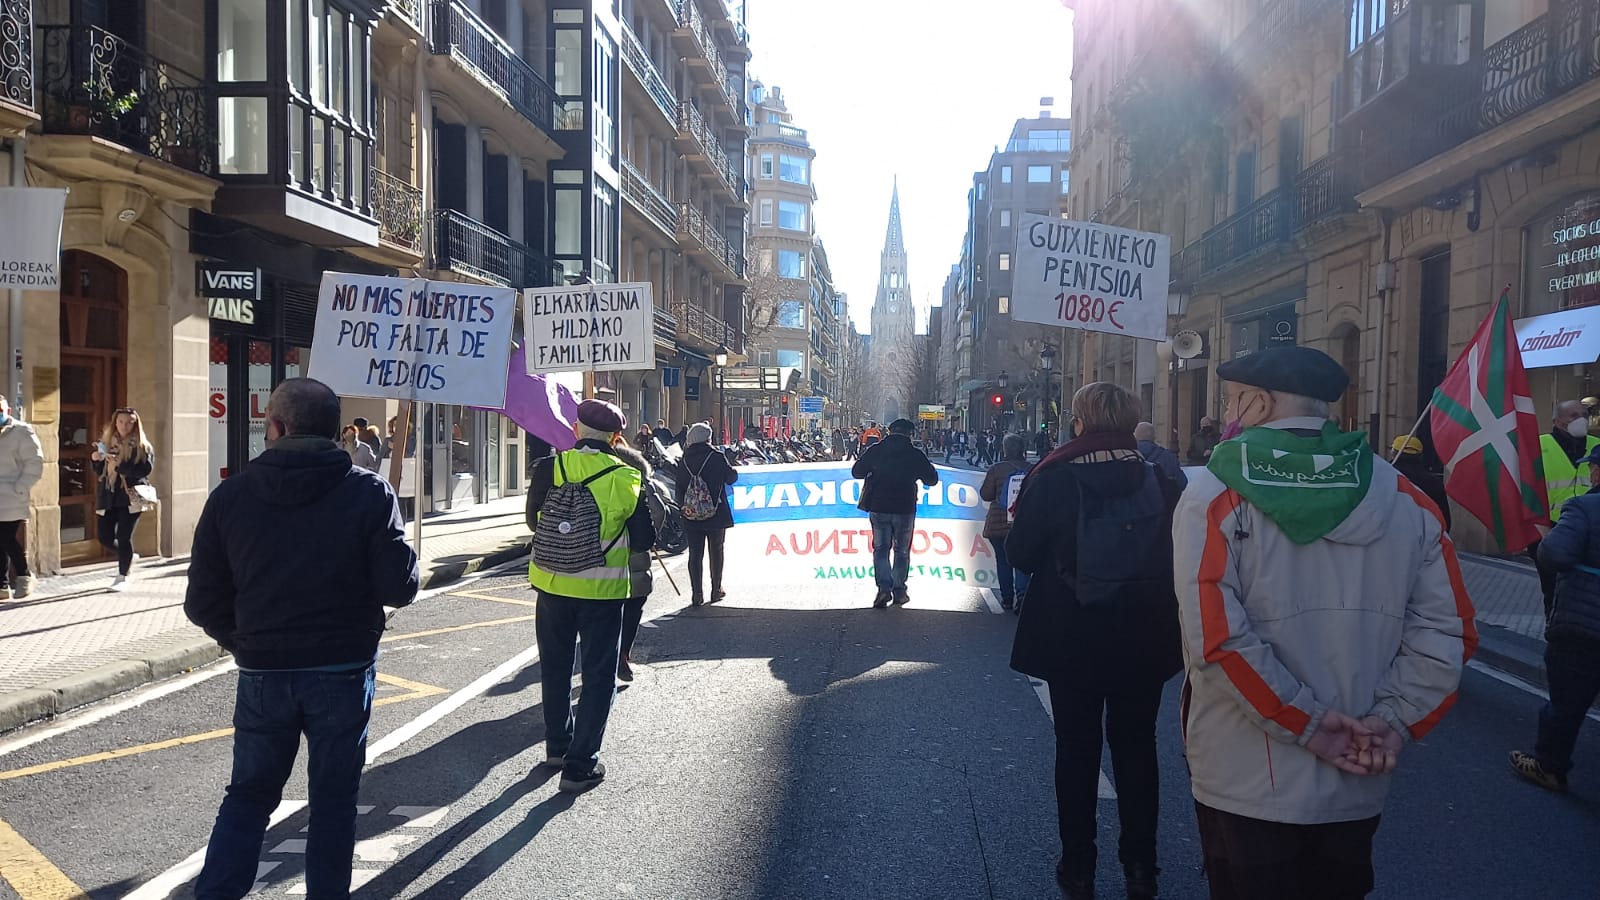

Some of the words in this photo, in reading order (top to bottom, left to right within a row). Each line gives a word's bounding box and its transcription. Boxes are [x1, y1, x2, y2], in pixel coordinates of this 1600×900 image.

[1029, 221, 1157, 269] GUTXIENEKO
[1, 260, 53, 273] LOREAK
[204, 269, 255, 290] VANS
[1043, 256, 1143, 301] PENTSIOA
[332, 283, 358, 312] NO
[362, 284, 403, 317] MAS
[407, 287, 495, 324] MUERTES
[533, 290, 640, 317] ELKARTASUNA
[1054, 292, 1125, 329] 1080€
[336, 319, 378, 350] POR
[387, 322, 449, 355] FALTA
[457, 329, 489, 359] DE
[551, 315, 622, 340] HILDAKO
[538, 341, 632, 365] FAMILIEKIN
[366, 358, 446, 390] MEDIOS
